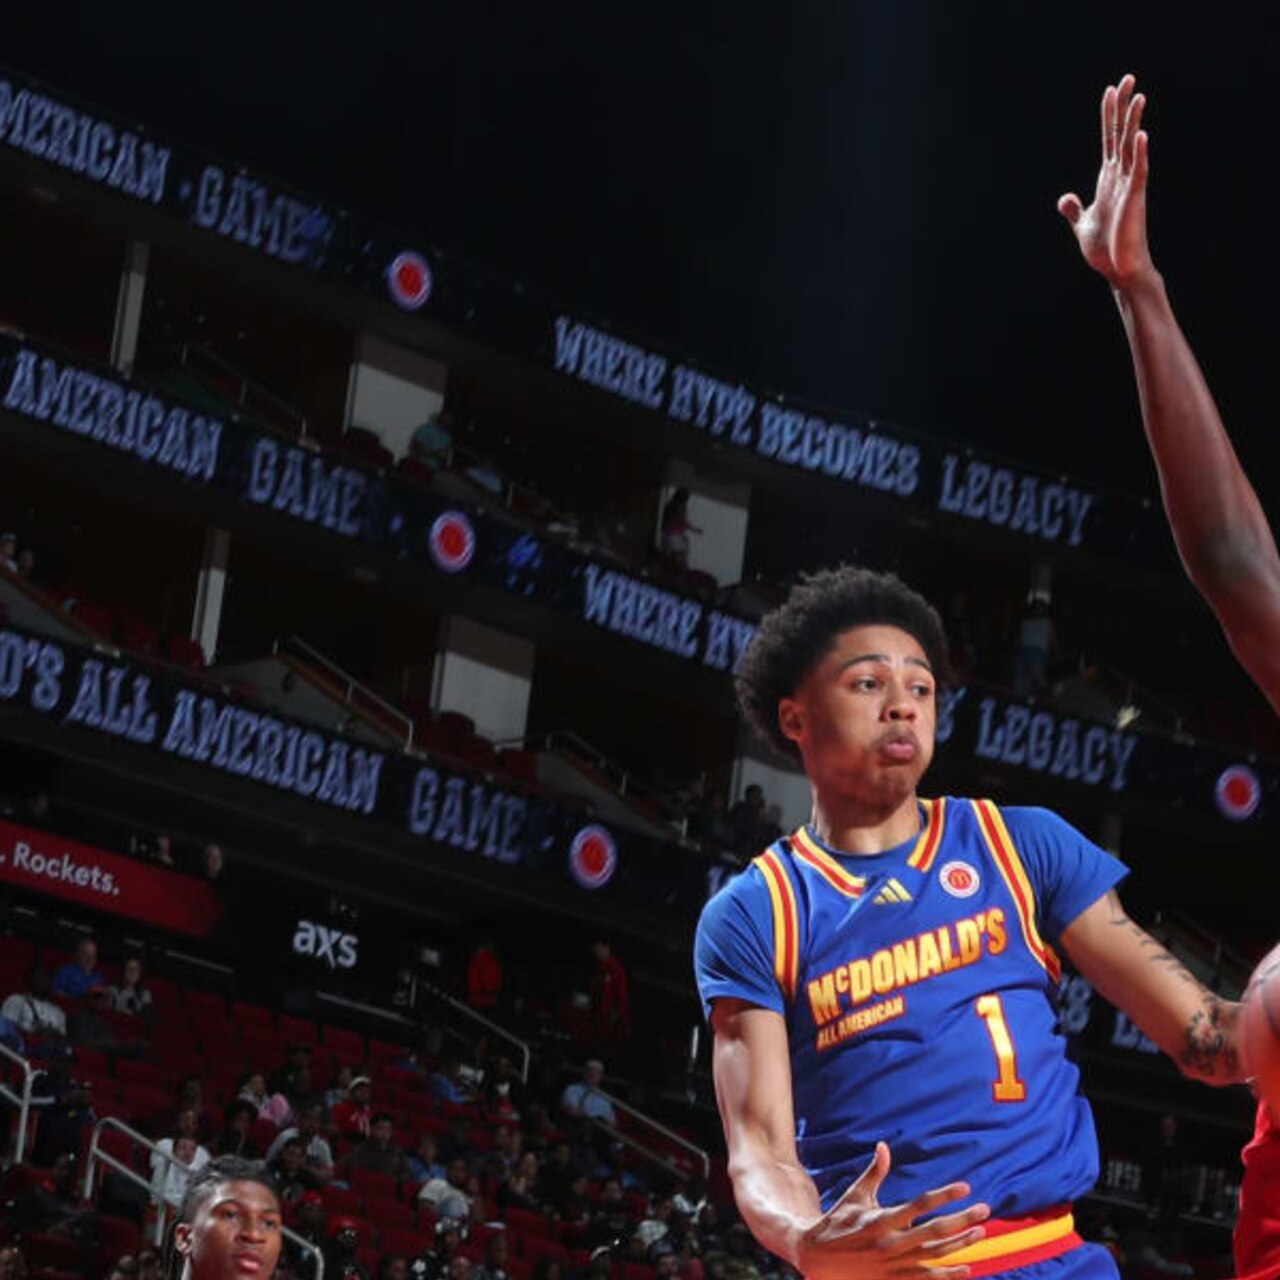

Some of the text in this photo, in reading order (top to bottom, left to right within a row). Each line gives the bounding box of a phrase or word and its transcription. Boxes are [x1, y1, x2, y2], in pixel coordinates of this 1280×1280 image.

[191, 165, 328, 269] GAME
[2, 347, 222, 482] AMERICAN
[248, 436, 368, 538] GAME
[553, 313, 1093, 547] WHERE HYPE BECOMES LEGACY
[581, 563, 758, 677] WHERE HY
[63, 658, 160, 744] ALL
[160, 687, 385, 816] AMERICAN
[408, 766, 525, 865] GAME
[974, 696, 1139, 793] LEGACY
[13, 841, 122, 897] Rockets.
[291, 918, 360, 971] axs
[806, 906, 1008, 1027] McDONALD'S
[838, 994, 906, 1040] AMERICAN
[974, 993, 1028, 1103] 1
